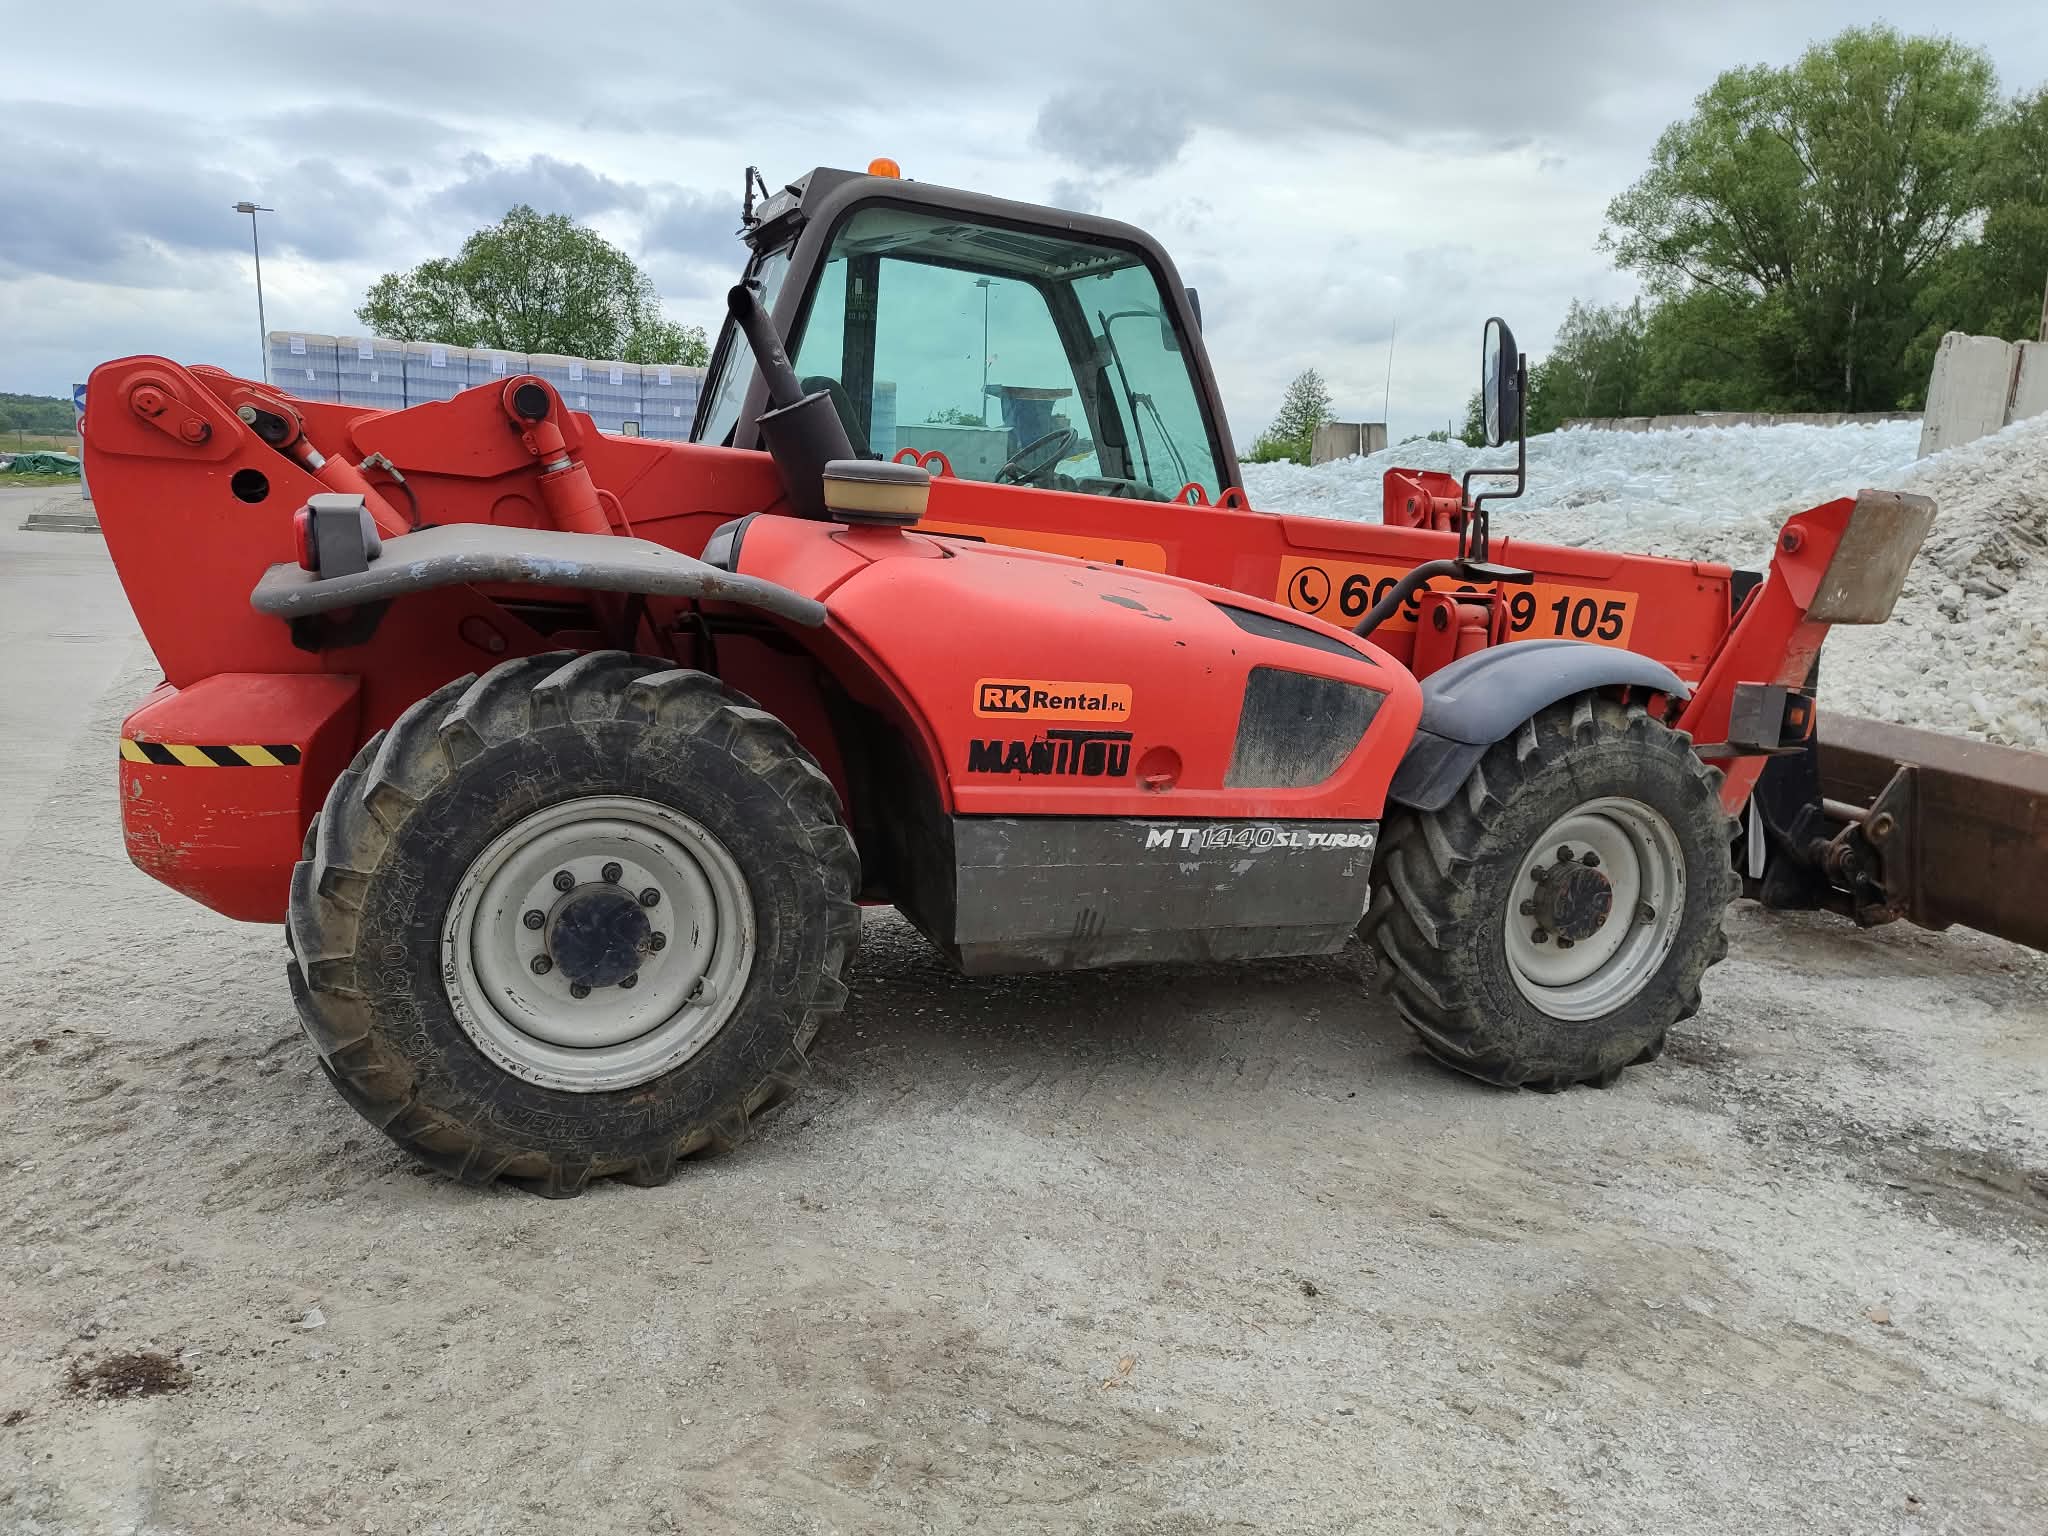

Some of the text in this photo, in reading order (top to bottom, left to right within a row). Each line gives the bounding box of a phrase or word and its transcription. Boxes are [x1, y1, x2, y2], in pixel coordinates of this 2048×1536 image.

[1551, 596, 1626, 641] 105
[984, 688, 1027, 709] RK
[968, 729, 1134, 776] MANITOU
[1308, 833, 1374, 848] TURBO
